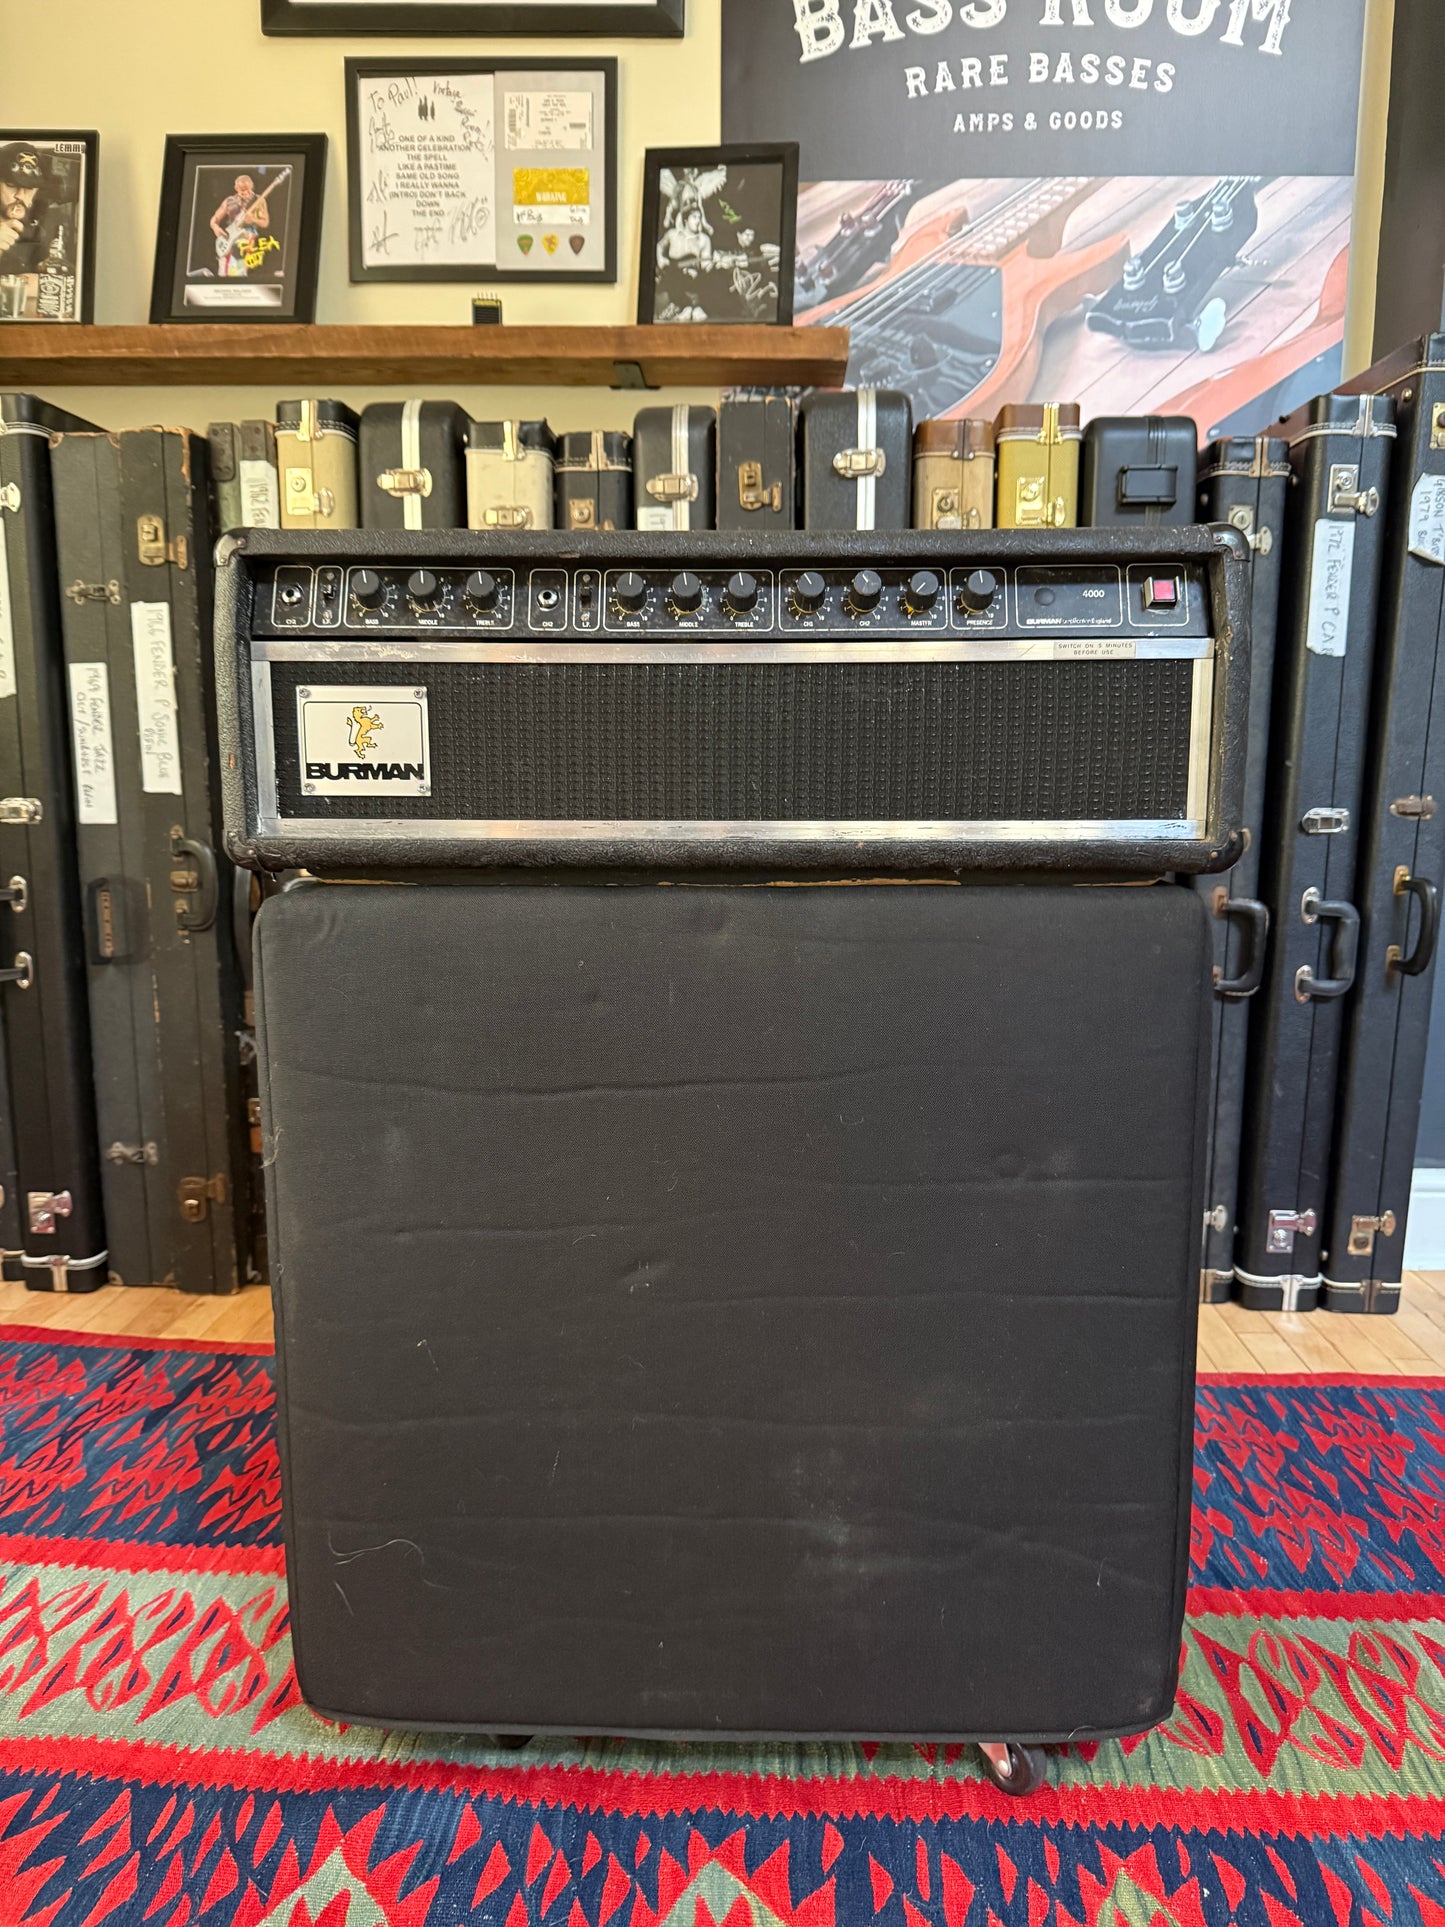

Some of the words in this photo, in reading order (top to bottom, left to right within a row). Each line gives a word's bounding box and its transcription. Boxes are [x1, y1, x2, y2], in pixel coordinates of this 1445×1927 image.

[904, 53, 1009, 99] RARE
[1028, 51, 1176, 93] BASSES
[953, 112, 1014, 133] AMPS
[1024, 112, 1038, 131] &
[1049, 110, 1123, 131] GOODS
[389, 191, 418, 199] (INTRO)
[420, 191, 442, 199] DON'T
[444, 191, 466, 199] BACK
[1419, 490, 1432, 522] 1979
[1082, 590, 1105, 598] 4000
[1324, 607, 1340, 616] P
[150, 638, 168, 690] FENDER
[154, 698, 170, 710] P
[306, 762, 424, 780] BURMAN
